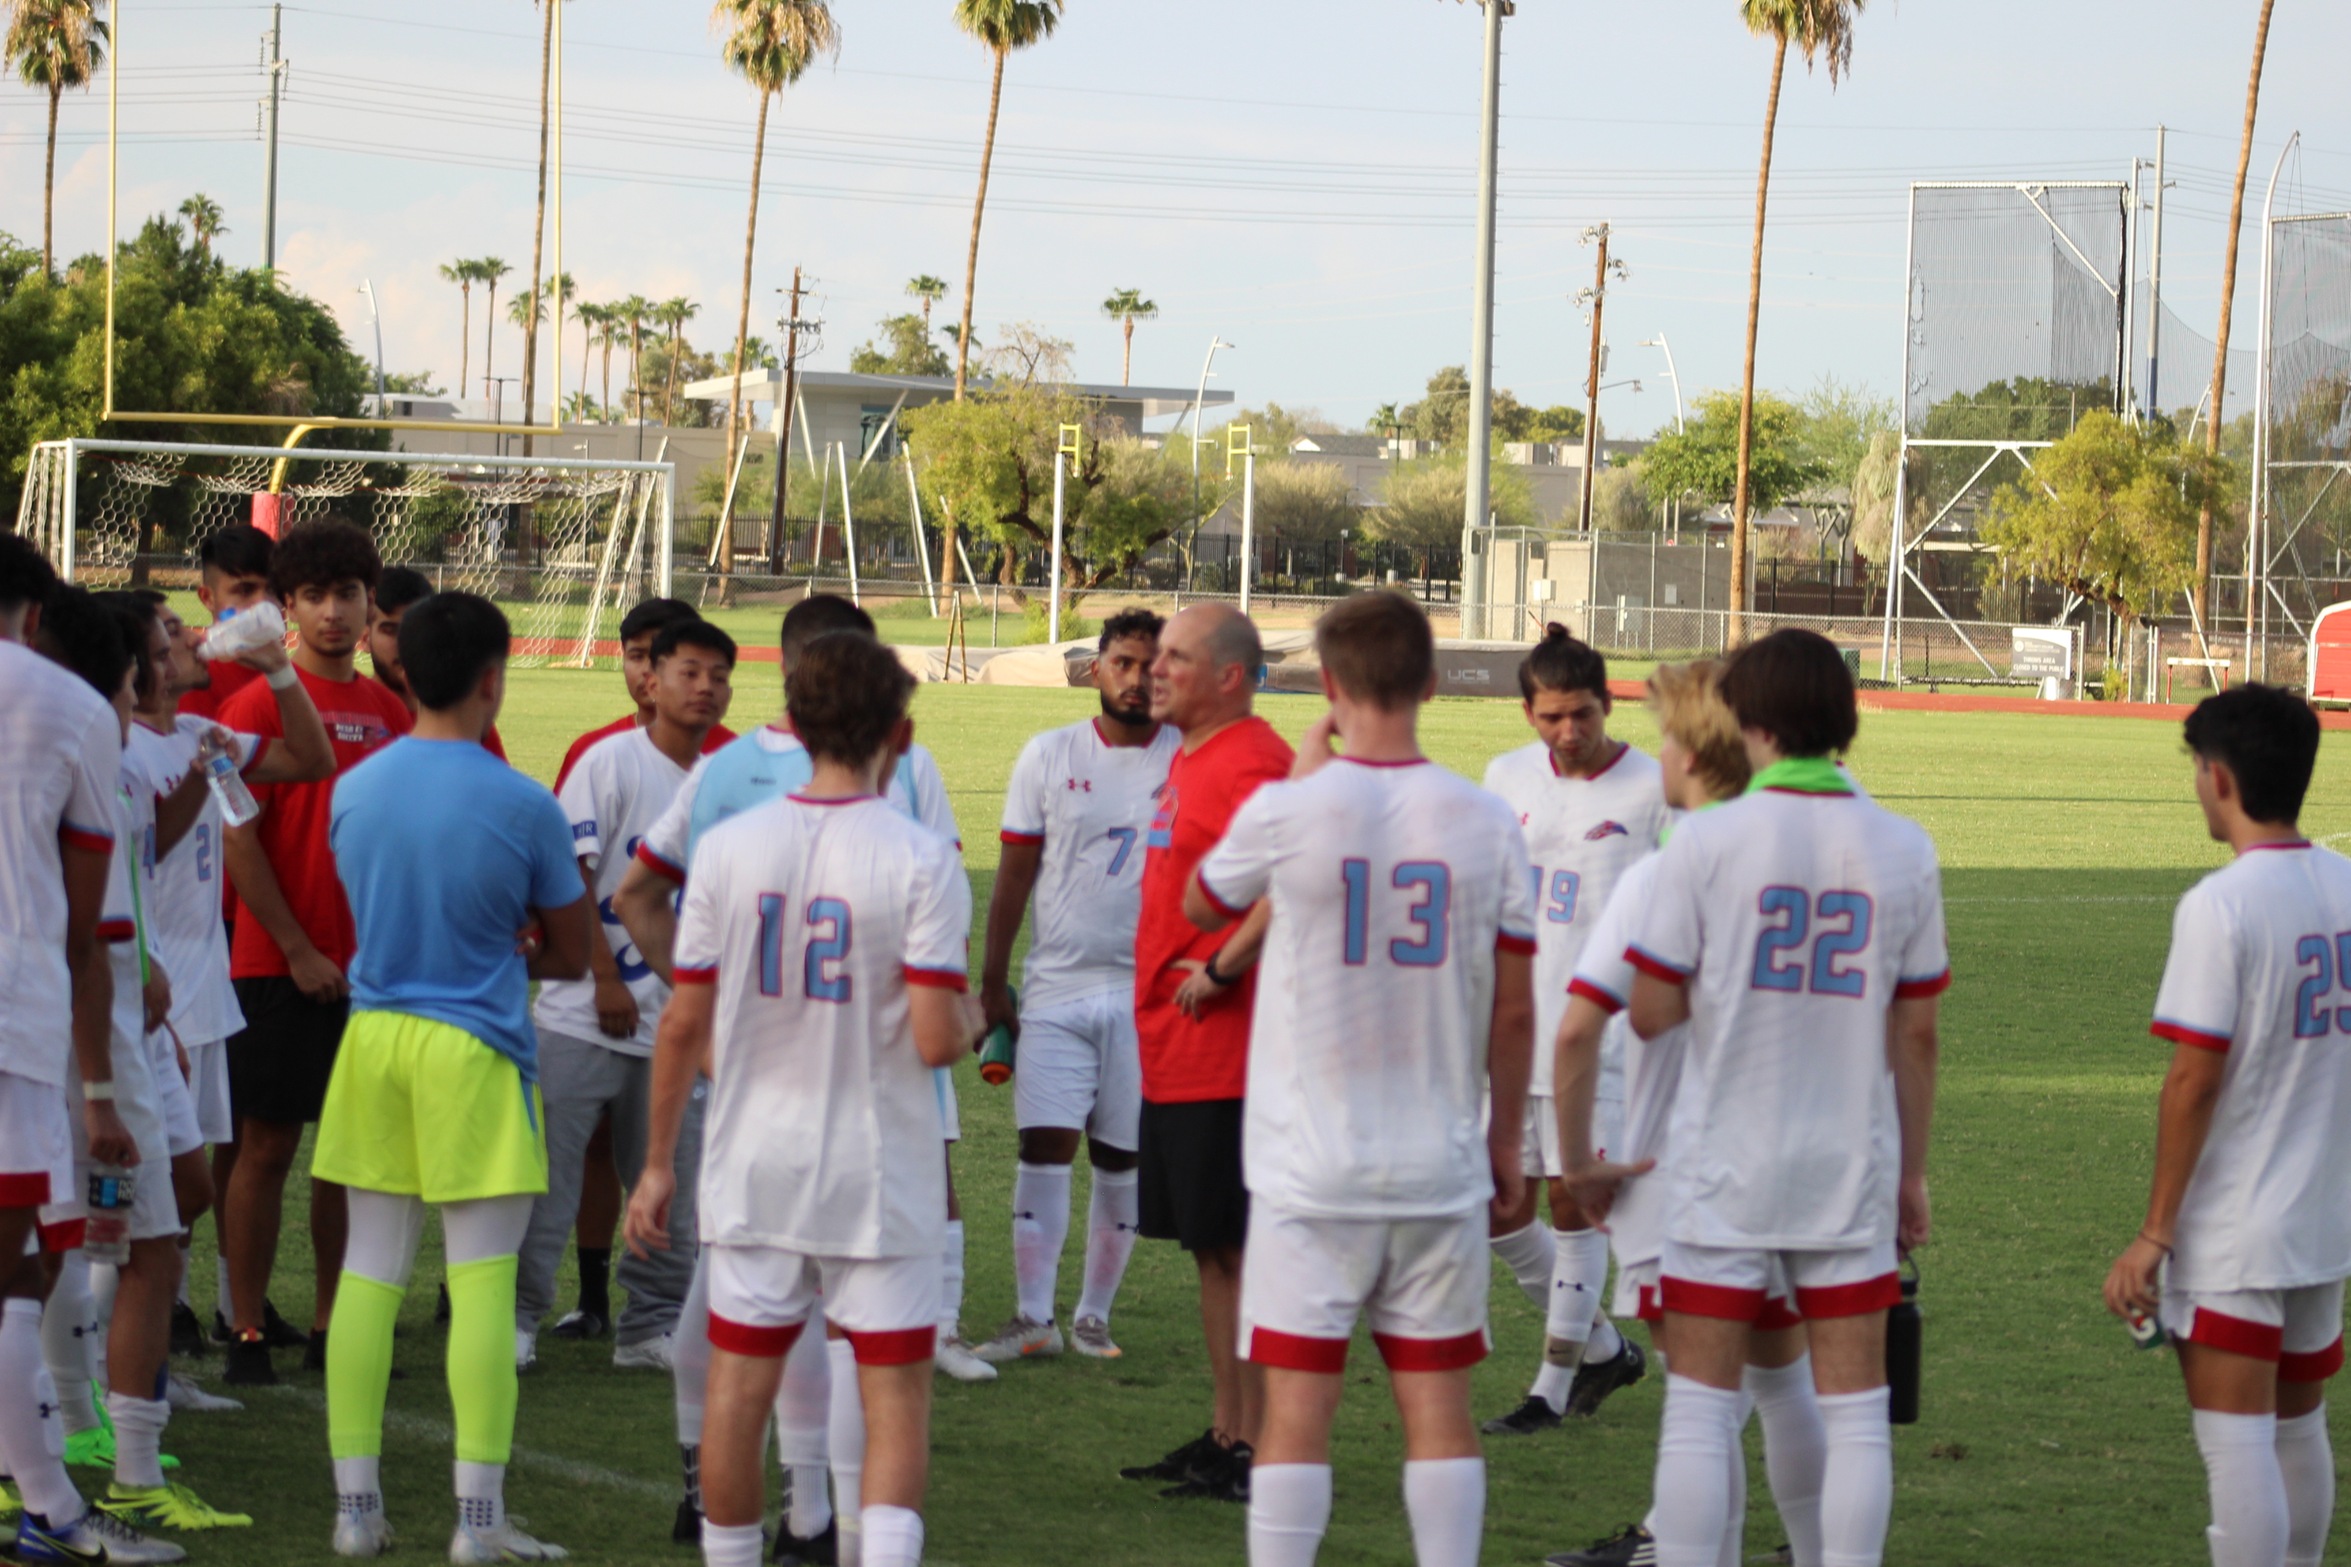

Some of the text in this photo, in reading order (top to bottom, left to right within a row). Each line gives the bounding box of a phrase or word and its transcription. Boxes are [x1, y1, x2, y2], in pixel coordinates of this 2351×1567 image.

[1447, 669, 1490, 681] UCS
[2042, 657, 2056, 665] AREA
[196, 823, 212, 882] 2
[1107, 827, 1138, 876] 7
[1343, 857, 1451, 968] 13
[1751, 885, 1874, 998] 22
[758, 892, 852, 1003] 12
